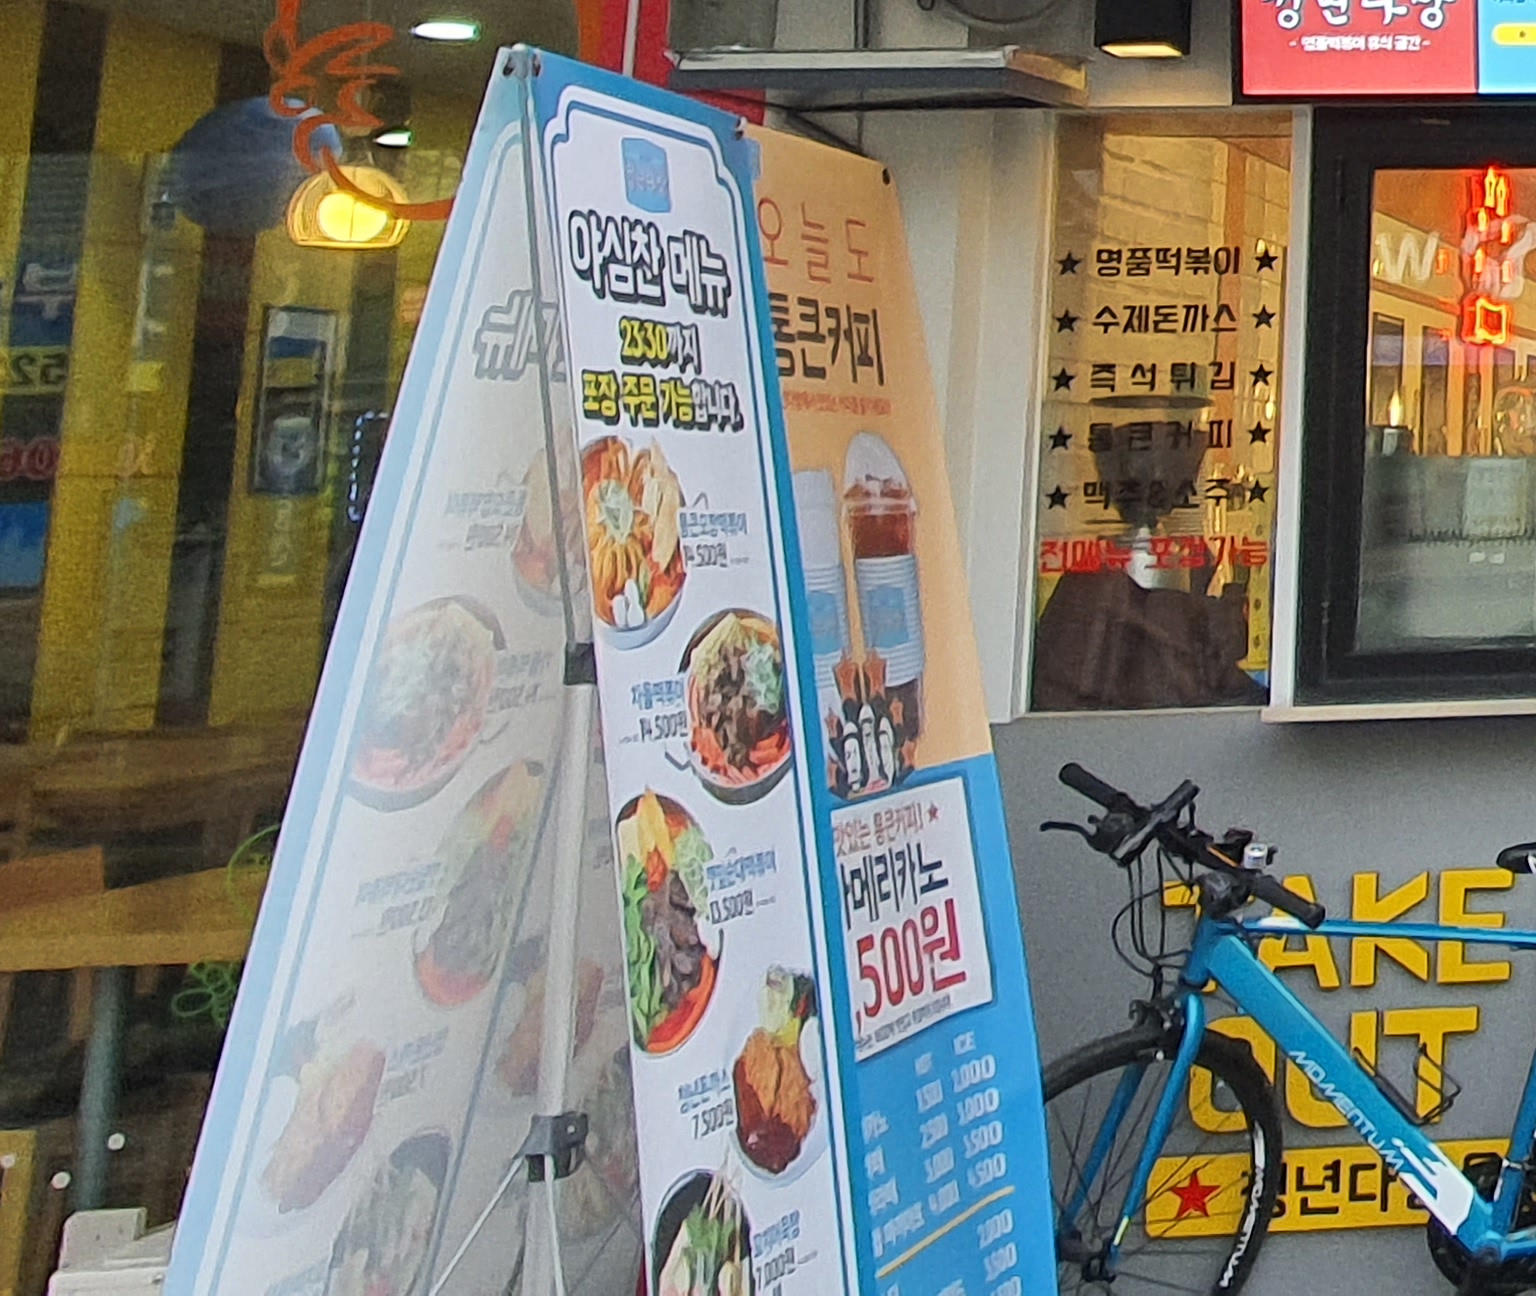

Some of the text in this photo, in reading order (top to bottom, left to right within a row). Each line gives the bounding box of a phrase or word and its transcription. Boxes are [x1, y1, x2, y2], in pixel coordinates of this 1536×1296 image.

[667, 230, 733, 318] 메뉴
[1096, 247, 1241, 277] 명품떡볶이
[769, 292, 885, 387] 통큰커피
[1092, 304, 1238, 334] 수제돈까스
[581, 369, 620, 426] 포장
[621, 372, 660, 428] 주문
[1289, 1050, 1405, 1172] MOMENTUM
[1241, 1157, 1428, 1220] 년다
